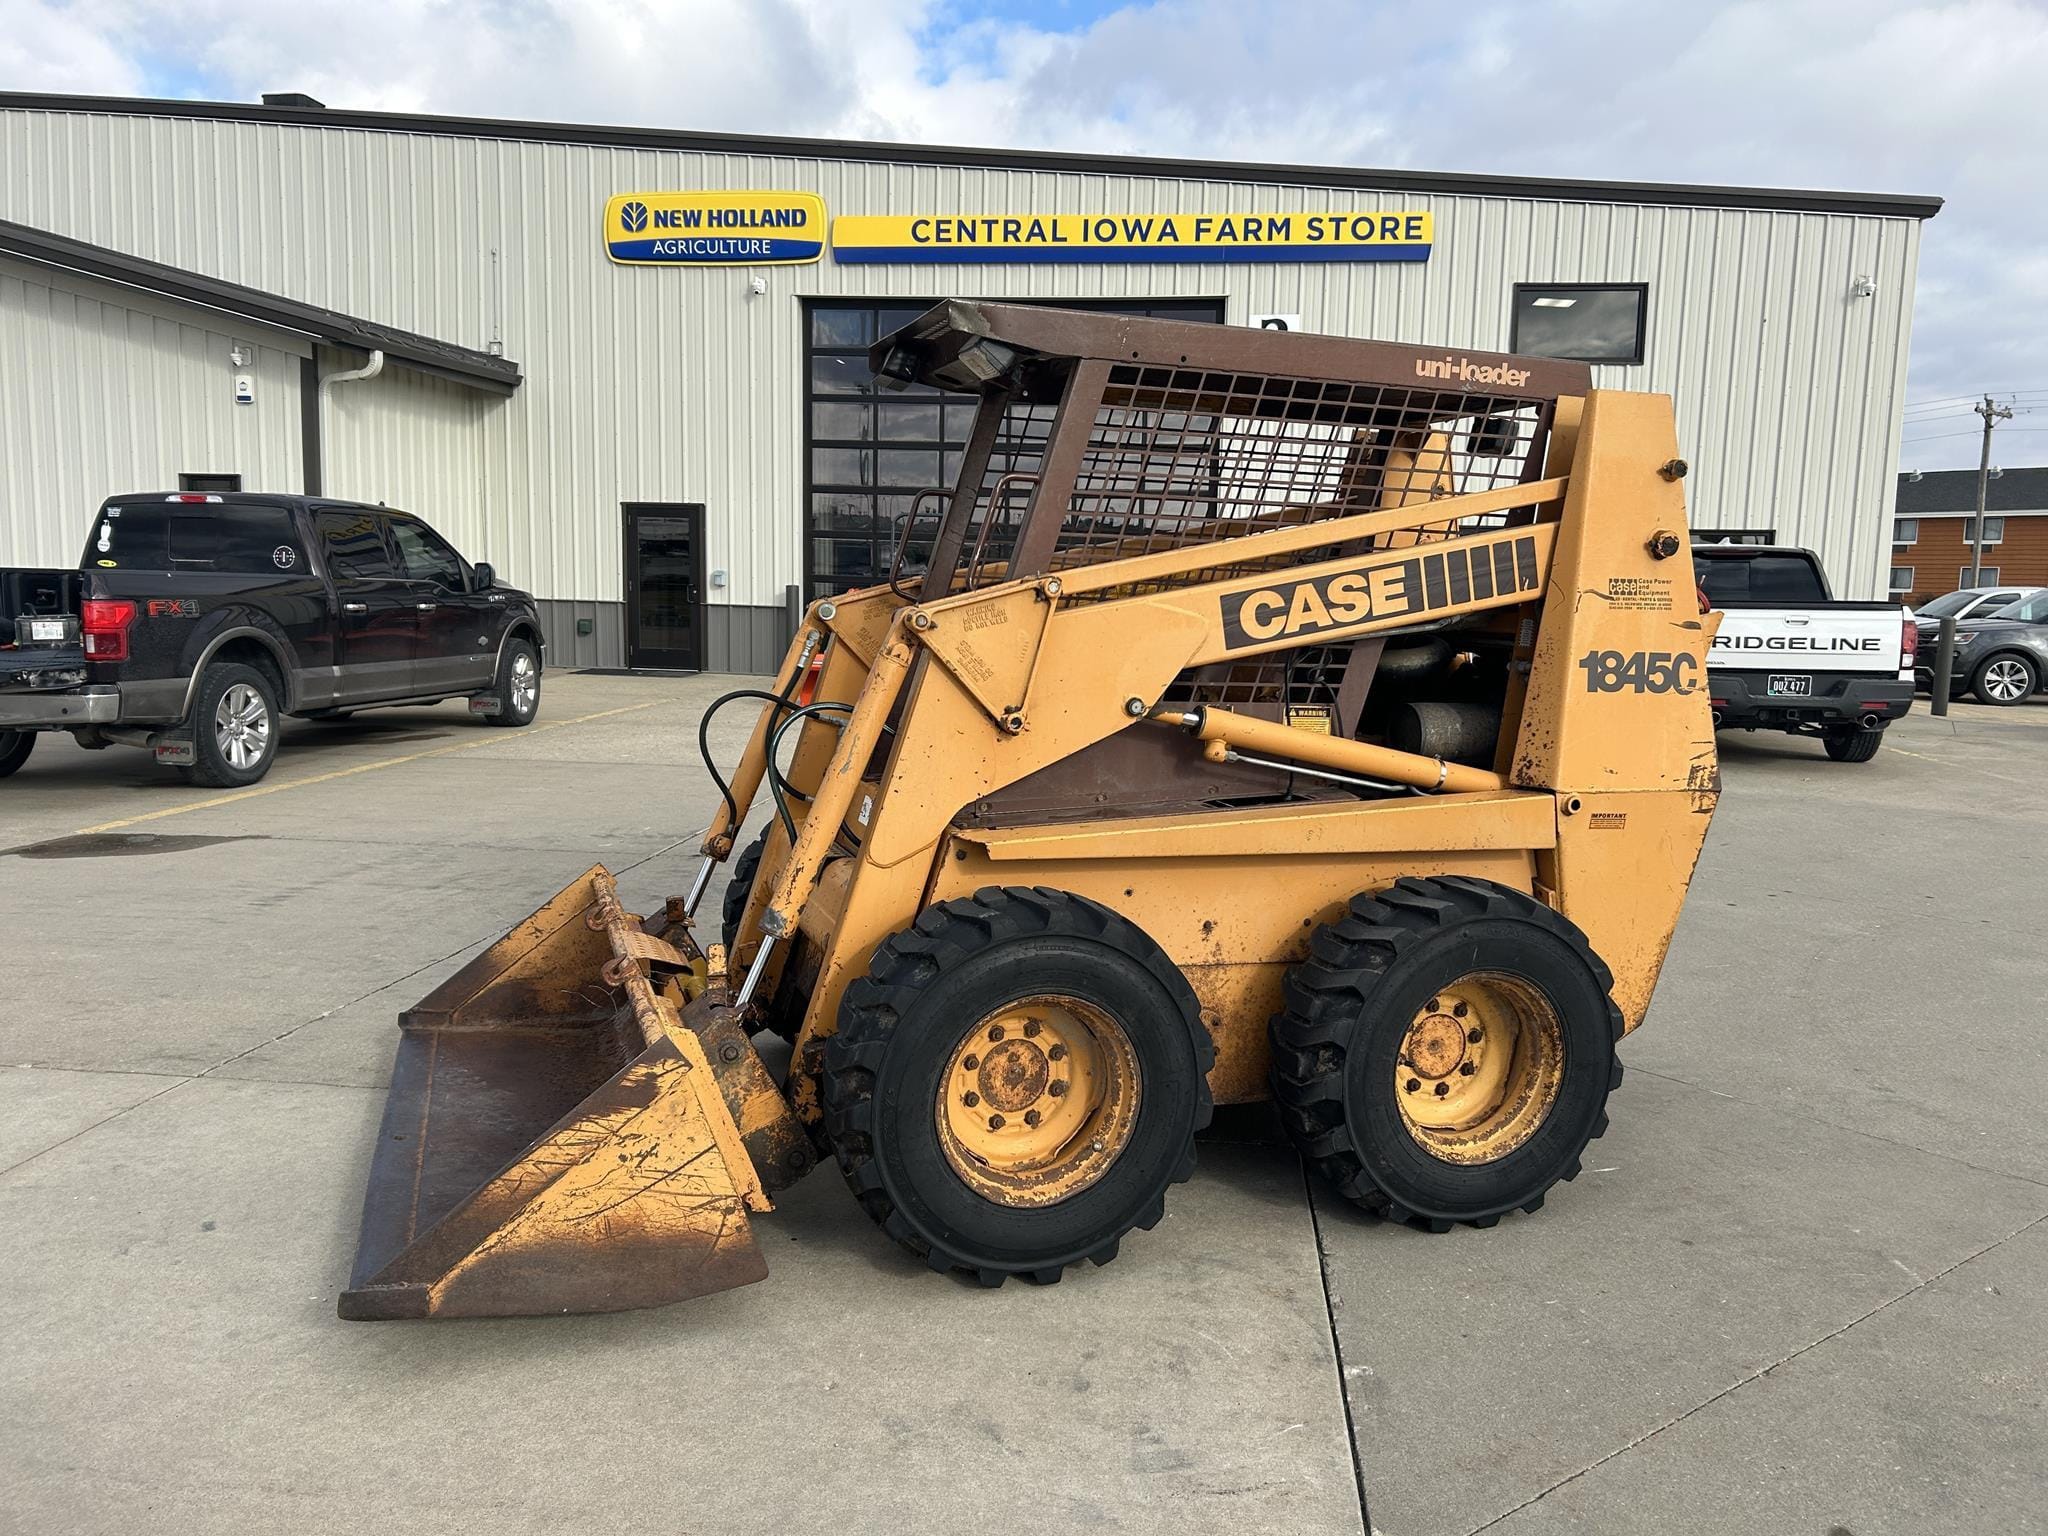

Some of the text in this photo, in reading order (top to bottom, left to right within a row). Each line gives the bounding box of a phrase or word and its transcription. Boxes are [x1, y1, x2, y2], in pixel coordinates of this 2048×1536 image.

[654, 208, 806, 228] NEW HOLLAND
[911, 216, 1423, 243] CENTRAL IOWA FARM STORE
[653, 239, 771, 255] AGRICULTURE
[1415, 356, 1531, 387] uni-loader
[147, 600, 200, 617] FX4
[1239, 565, 1409, 640] CASE
[1712, 636, 1881, 651] RIDGELINE
[1579, 650, 1698, 696] 1845C
[1790, 681, 1805, 692] 477
